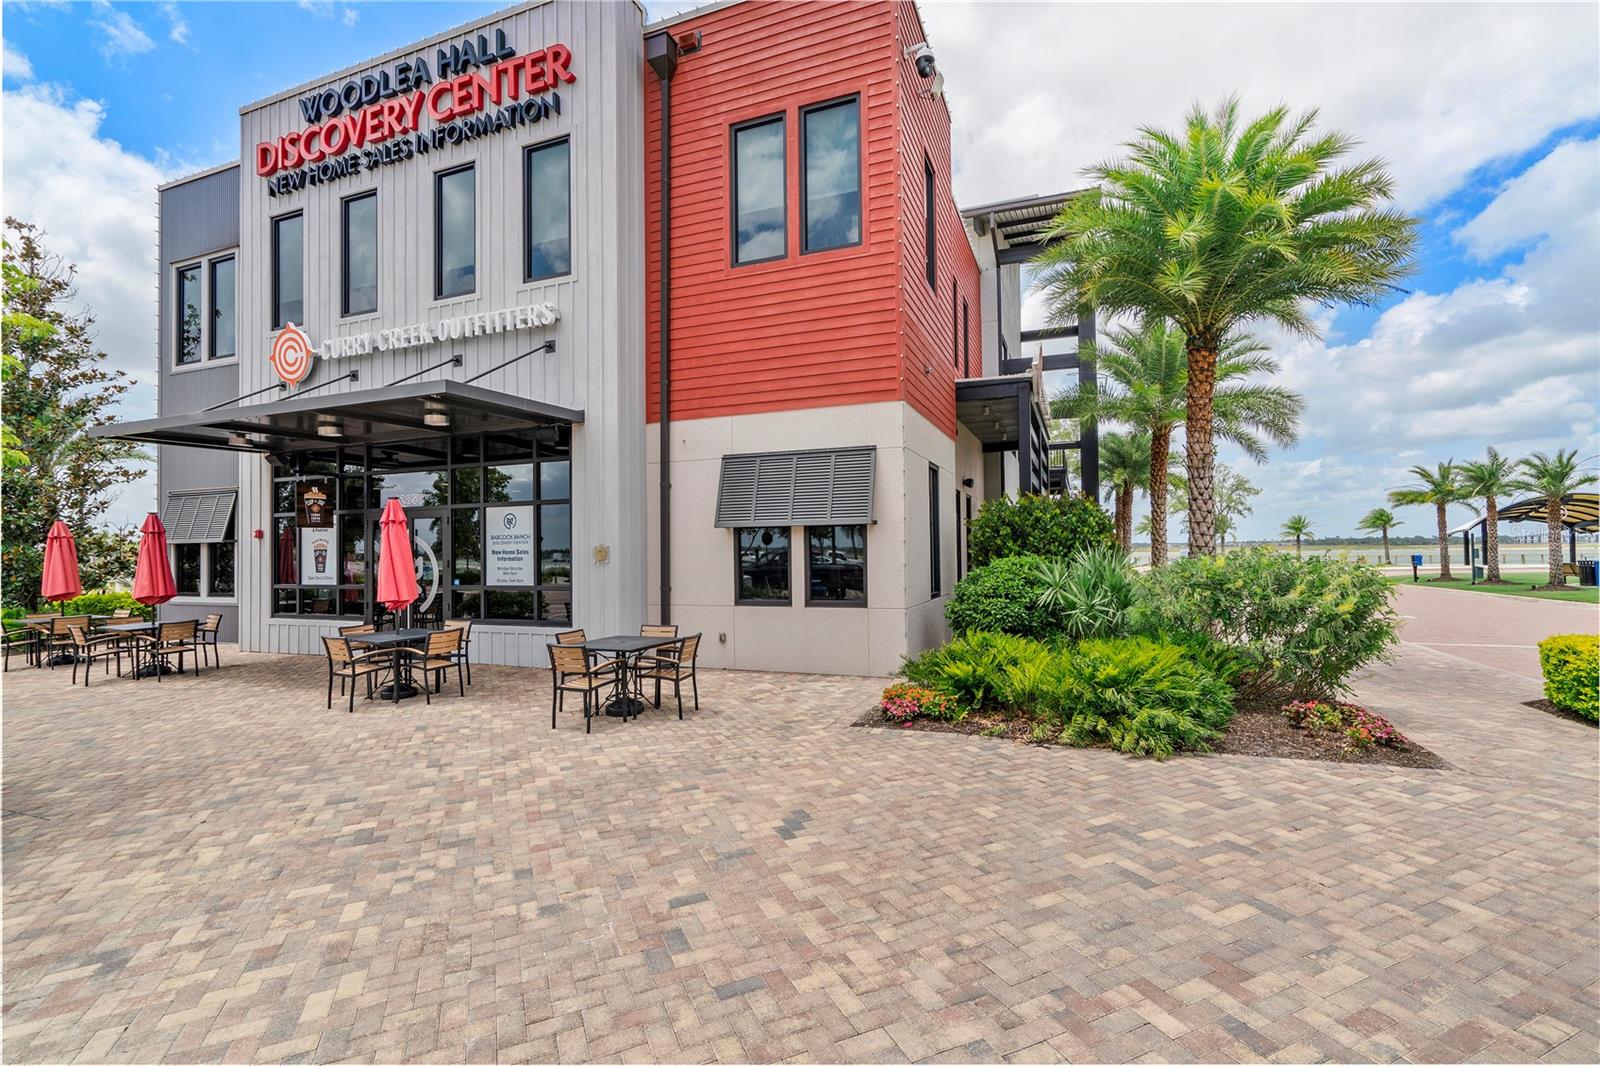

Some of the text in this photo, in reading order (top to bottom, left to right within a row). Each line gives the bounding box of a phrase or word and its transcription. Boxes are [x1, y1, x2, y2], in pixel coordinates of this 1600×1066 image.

[256, 43, 576, 177] DISCOVERY CENTER
[299, 28, 516, 124] WOODLEA HALL
[268, 91, 561, 198] NEW HOME SALES INFORMATION
[321, 301, 560, 360] CURRY CREEK OUTFITTERS
